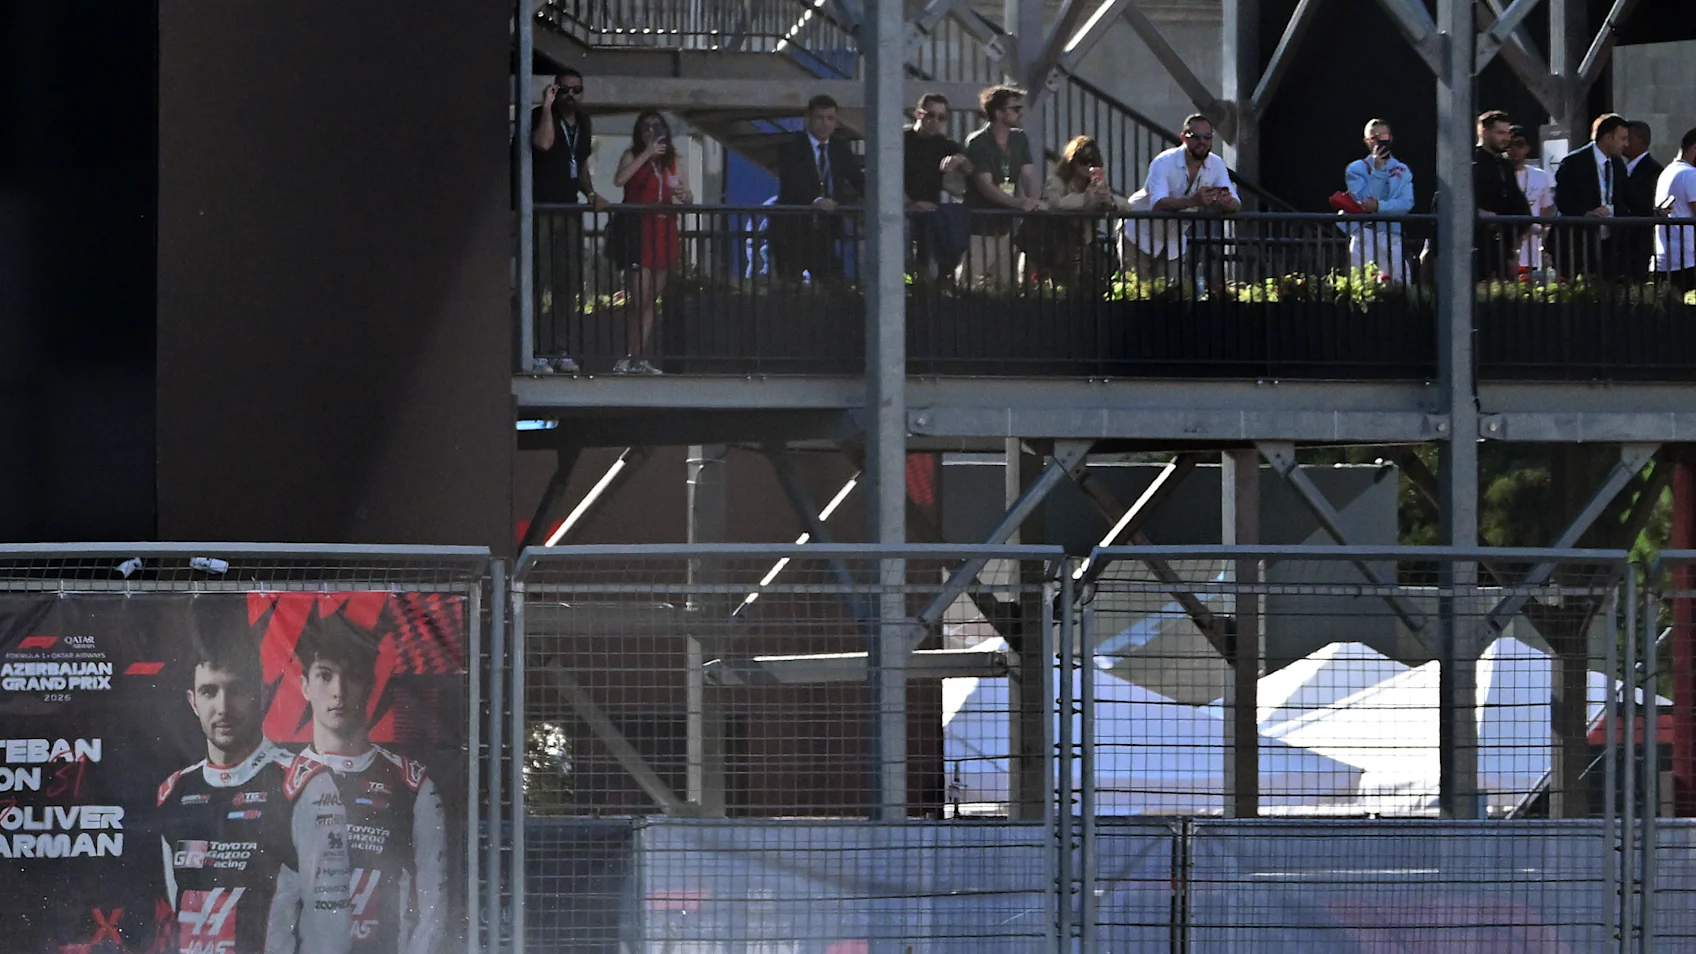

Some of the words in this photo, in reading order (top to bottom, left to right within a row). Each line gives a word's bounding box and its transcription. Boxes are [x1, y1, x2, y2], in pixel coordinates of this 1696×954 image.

[64, 635, 95, 645] QATAR
[0, 662, 113, 677] AZERBAIJAN
[1, 676, 67, 691] GRAND
[68, 676, 112, 690] PRIX
[0, 805, 125, 830] OLIVER
[209, 841, 257, 850] TOYOTA
